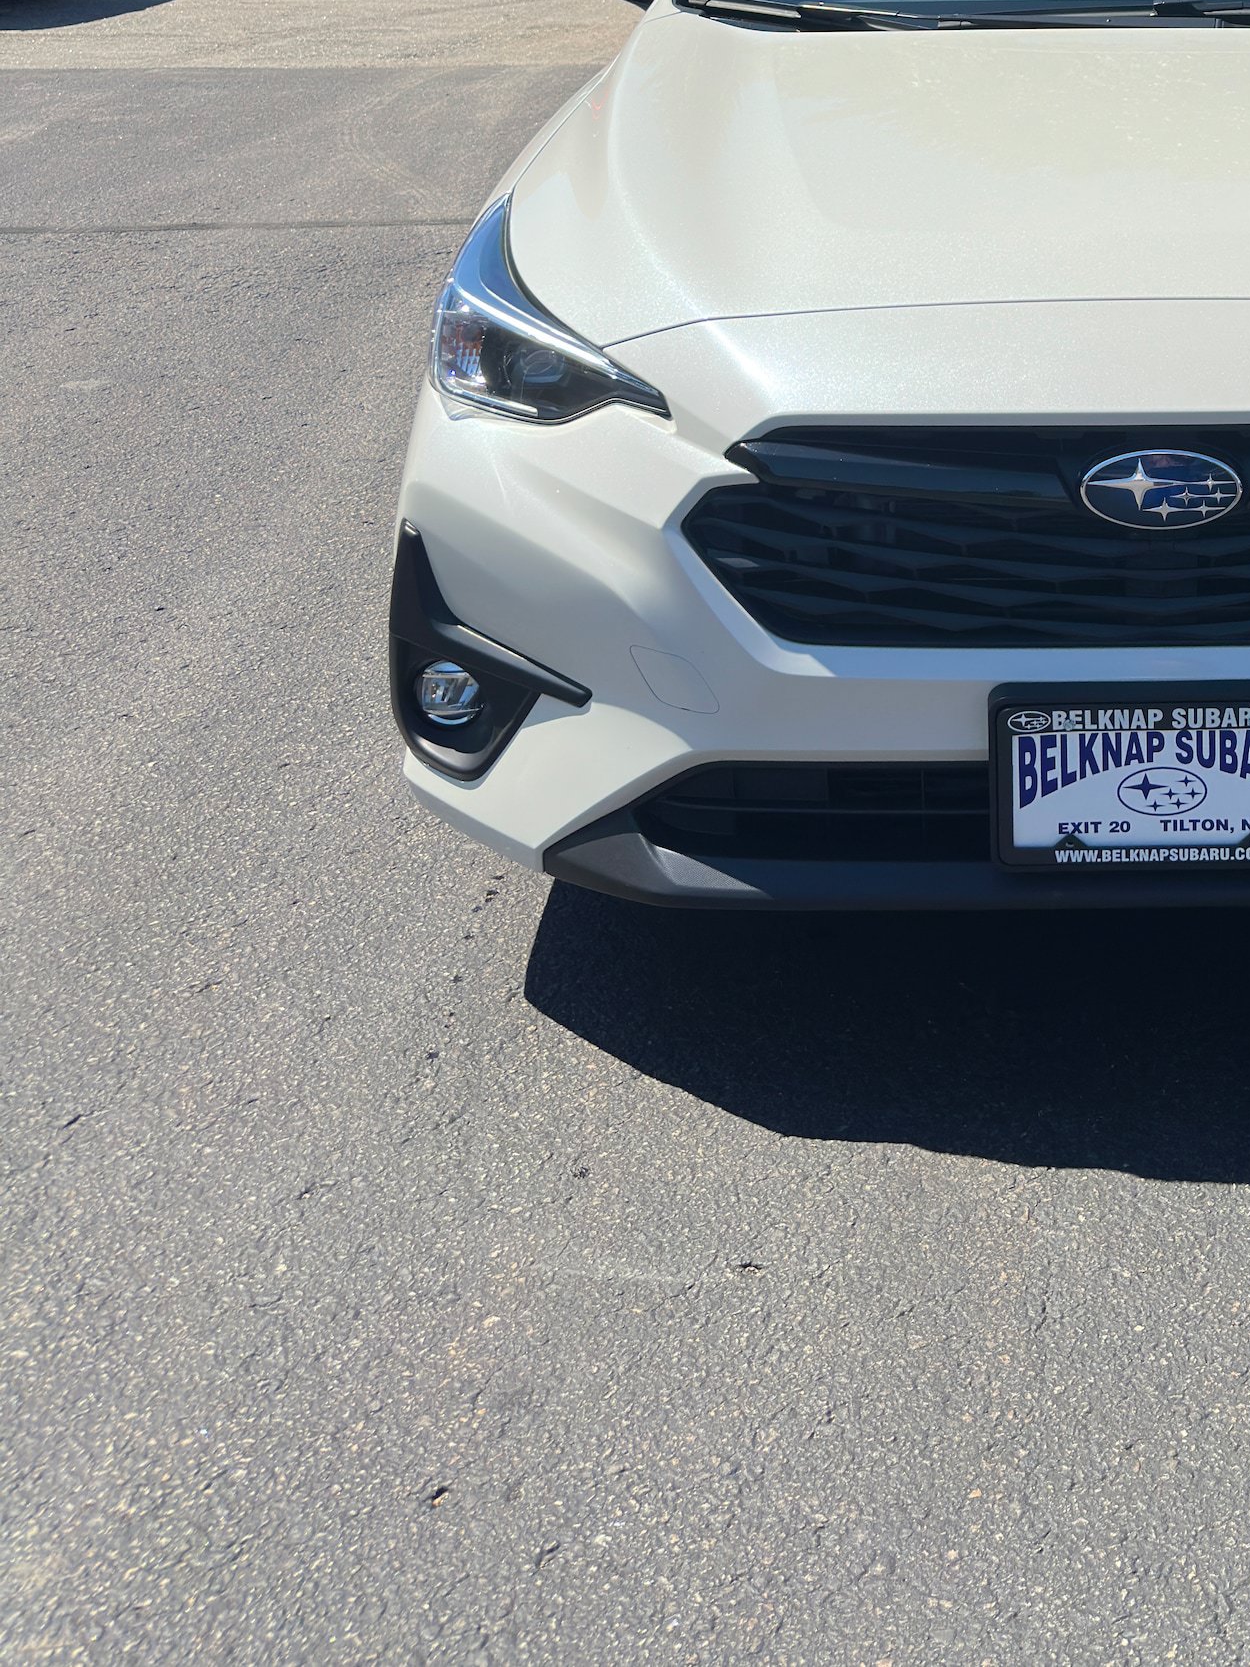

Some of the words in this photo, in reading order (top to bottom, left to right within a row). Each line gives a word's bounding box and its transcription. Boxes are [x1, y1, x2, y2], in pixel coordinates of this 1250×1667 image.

[1052, 708, 1164, 731] BELKNAP
[1019, 731, 1165, 809] BELKNAP
[1058, 821, 1102, 835] EXIT
[1109, 820, 1131, 833] 20
[1160, 819, 1235, 834] TILTON,
